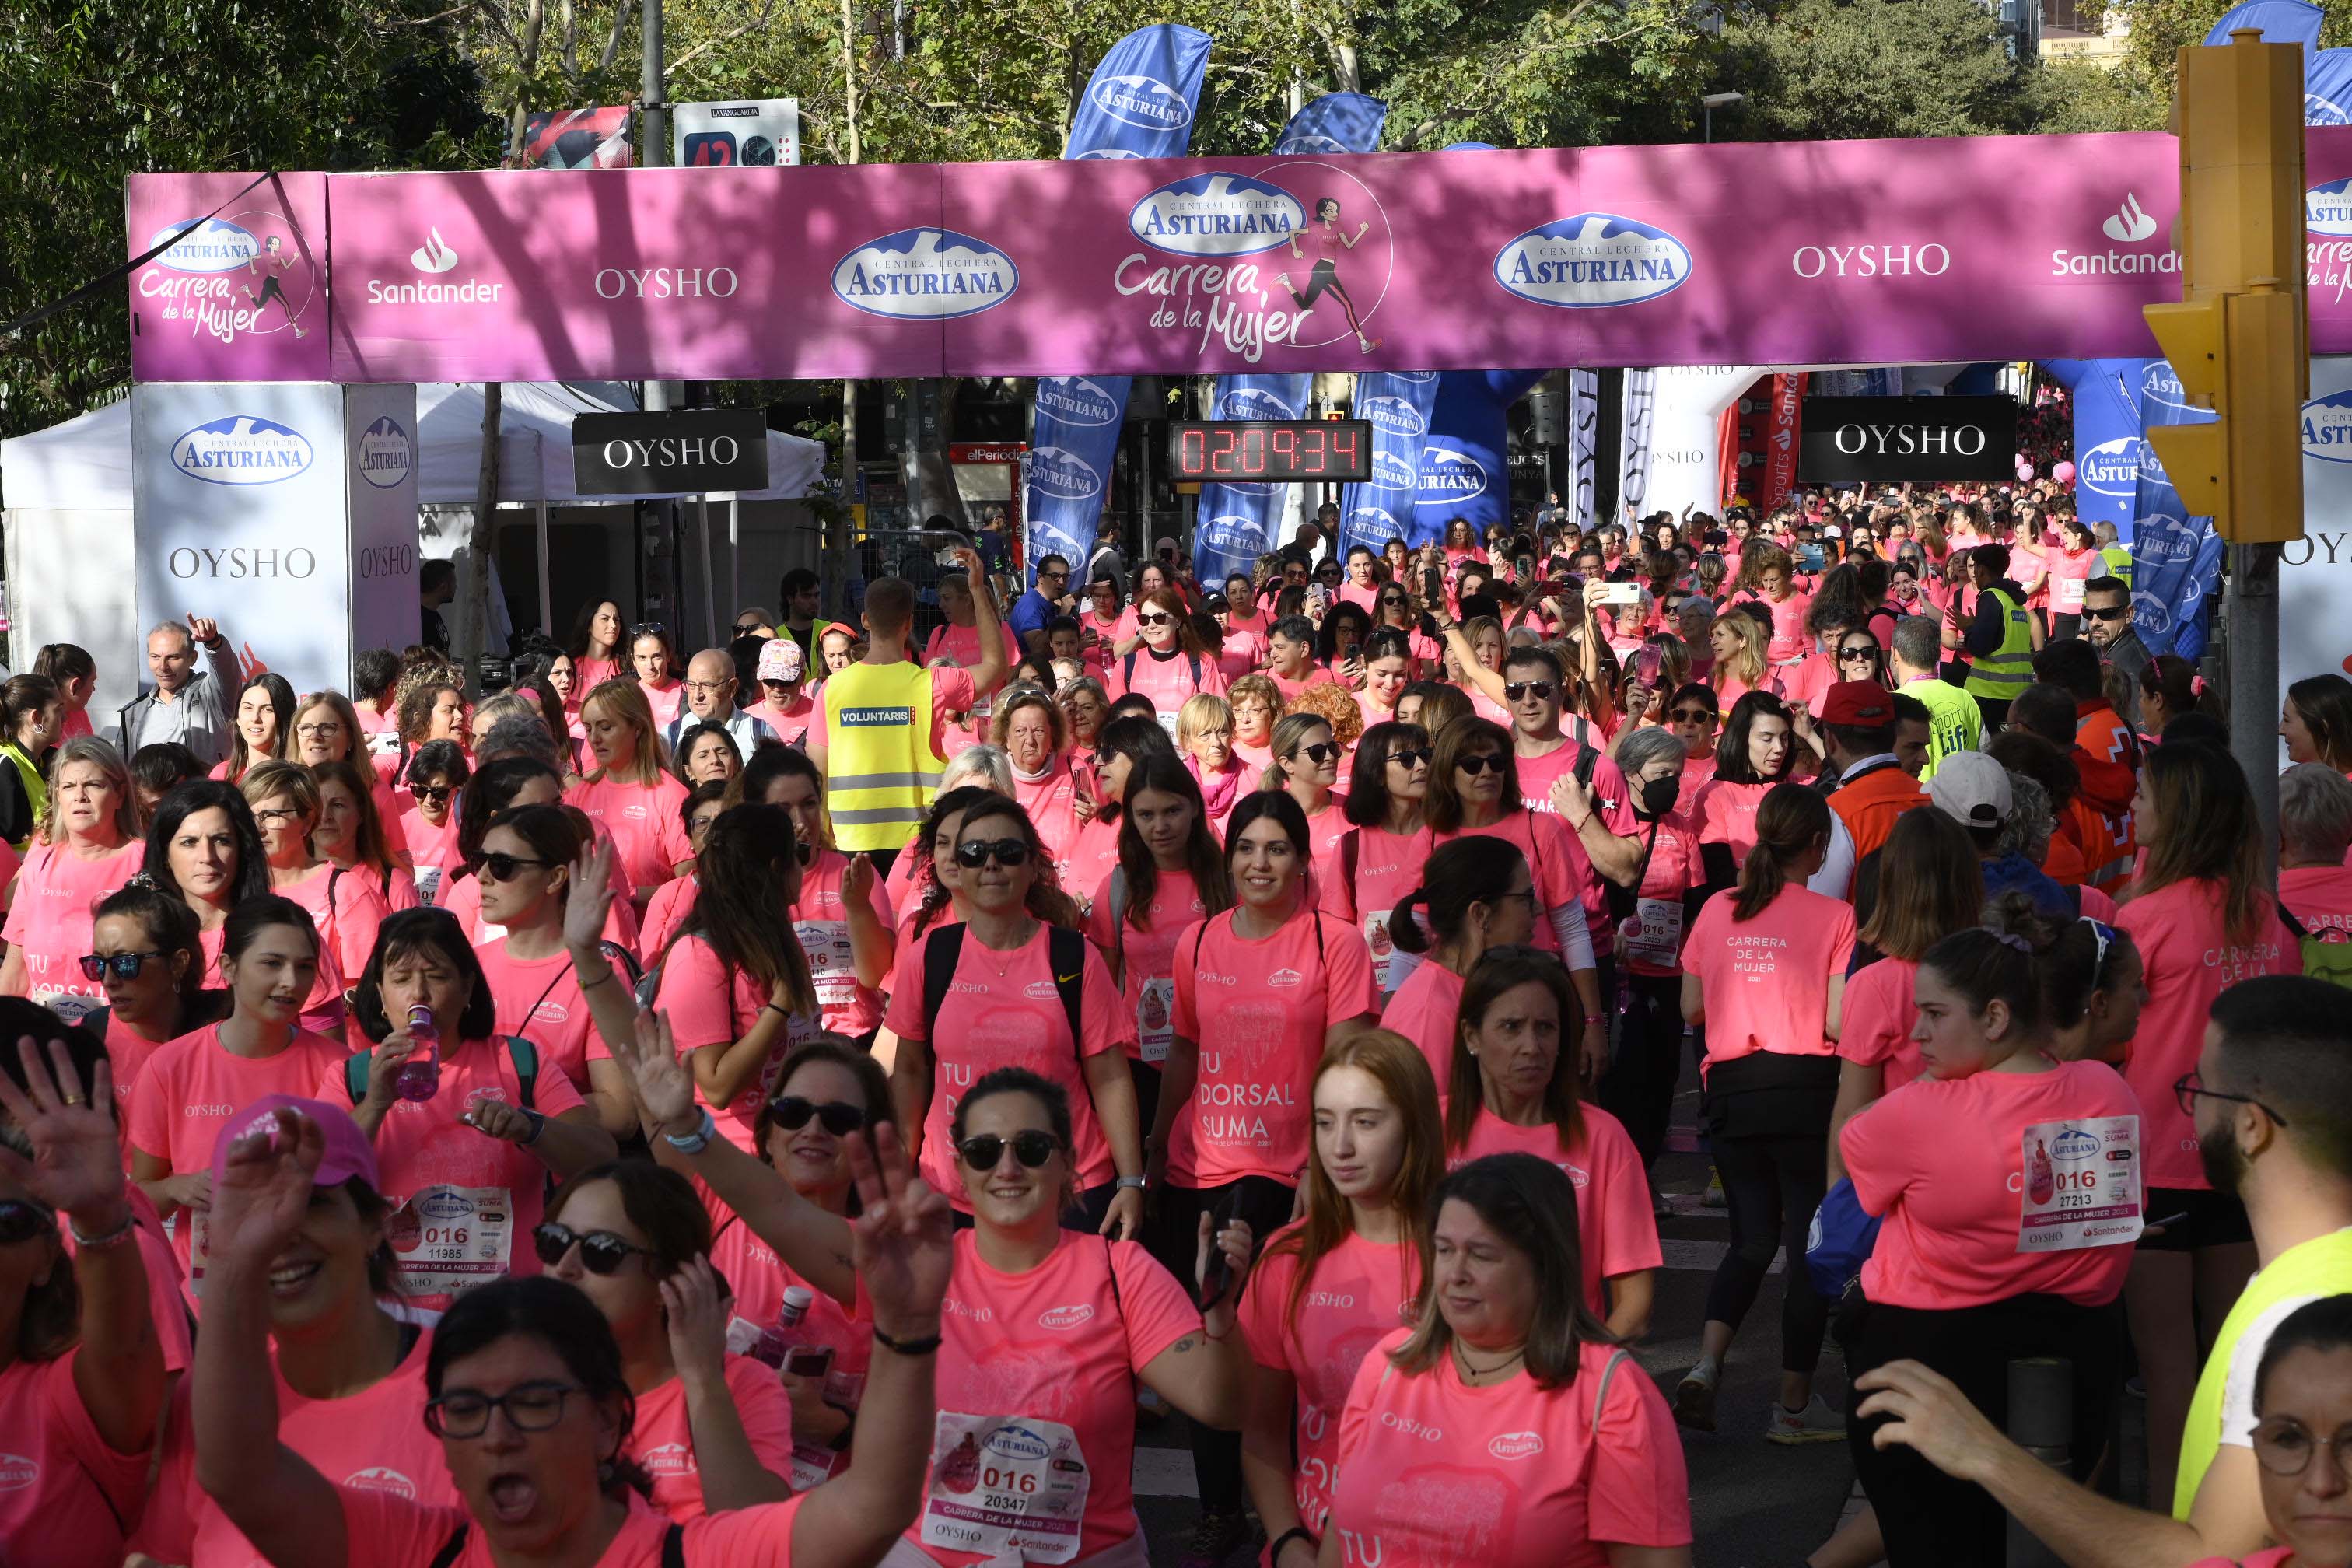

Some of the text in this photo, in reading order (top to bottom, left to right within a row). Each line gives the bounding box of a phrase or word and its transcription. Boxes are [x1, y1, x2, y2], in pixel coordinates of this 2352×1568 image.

[720, 107, 758, 117] VANGUARDIA
[1099, 85, 1182, 124] ASTURIANA
[1170, 200, 1287, 211] CENTRAL LECHERA
[2306, 202, 2352, 222] ASTU
[1143, 205, 1291, 236] ASTURIANA
[1539, 243, 1670, 257] CENTRAL LECHERA
[1793, 243, 1951, 278] OYSHO
[874, 257, 997, 269] CENTRAL LECHERA
[1114, 253, 1260, 296] Carrera
[1509, 249, 1676, 285] ASTURIANA
[138, 269, 231, 298] Carrera
[595, 266, 737, 299] OYSHO
[845, 262, 1004, 296] ASTURIANA
[2325, 265, 2339, 286] la
[367, 278, 503, 304] Santander
[162, 295, 265, 343] de la Mujer
[1150, 290, 1314, 363] de la Mujer
[1036, 383, 1108, 420] ASTURIANA
[1226, 397, 1288, 420] ASTURIAN
[1362, 404, 1419, 432] ASTURIANA
[1835, 423, 1986, 455] OYSHO
[182, 442, 303, 468] ASTURIANA
[362, 446, 408, 471] ASTURIANA
[604, 436, 740, 468] OYSHO
[1182, 429, 1356, 473] 02:09:34
[1031, 466, 1092, 493] STURIANA
[1769, 453, 1790, 508] Sports
[1205, 527, 1265, 554] ASTURIAN
[2279, 533, 2352, 565] OY
[169, 548, 316, 579] OYSHO
[361, 544, 412, 579] OYSHO
[842, 711, 908, 722] VOLUNTARIS
[1365, 864, 1398, 877] OYSHO
[1643, 924, 1664, 935] 016
[1727, 937, 1787, 947] CARRERA
[29, 954, 49, 974] TU
[808, 953, 828, 964] 16
[1737, 950, 1774, 960] DE LA
[2203, 944, 2280, 967] CARRERA
[1199, 972, 1236, 985] OYSHO
[1734, 962, 1776, 973] MUJER
[31, 983, 107, 999] ORSAL
[943, 1062, 971, 1087] TU
[1199, 1052, 1221, 1074] TU
[1201, 1083, 1294, 1106] DORSAL
[185, 1104, 233, 1117] OYSHO
[1202, 1116, 1269, 1138] SUMA
[2054, 1143, 2096, 1155] ASTURIANA
[2056, 1171, 2096, 1190] 016
[2060, 1195, 2091, 1206] 27213
[2034, 1215, 2061, 1224] CARRERA
[425, 1227, 467, 1244] 016
[2029, 1226, 2133, 1244] OYSHO Santander
[429, 1248, 462, 1258] 11985
[1381, 1412, 1539, 1455] OYSHO ASTURIANA
[989, 1436, 1045, 1456] ASTURIANA
[792, 1468, 816, 1482] nder
[983, 1468, 1037, 1493] 016
[985, 1494, 1026, 1510] 20347
[943, 1505, 984, 1521] CARRERA
[986, 1514, 999, 1523] DE
[1001, 1517, 1012, 1525] LA
[1014, 1519, 1043, 1528] MUJER
[936, 1524, 1069, 1552] OYSHO Santander
[1339, 1528, 1382, 1568] TU
